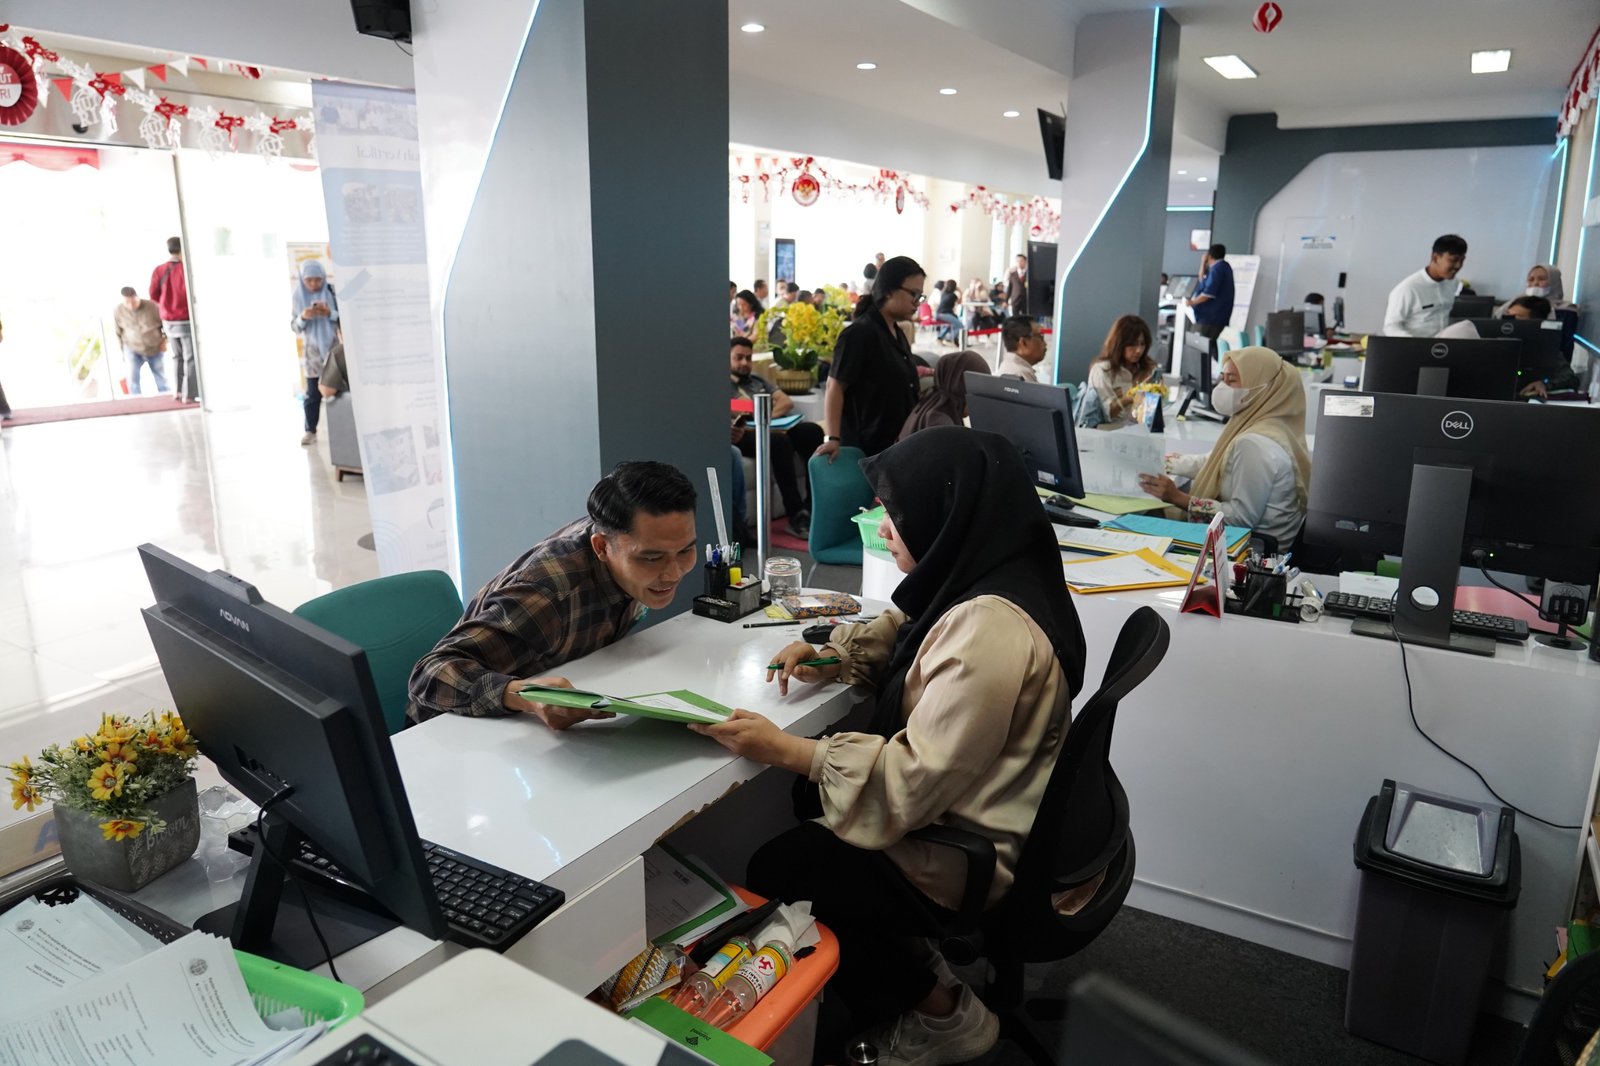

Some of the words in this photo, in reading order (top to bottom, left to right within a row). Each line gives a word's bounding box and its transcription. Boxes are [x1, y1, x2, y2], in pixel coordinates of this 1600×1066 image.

[0, 73, 12, 84] UT
[1445, 420, 1470, 430] DELL
[219, 608, 250, 632] ADVAN
